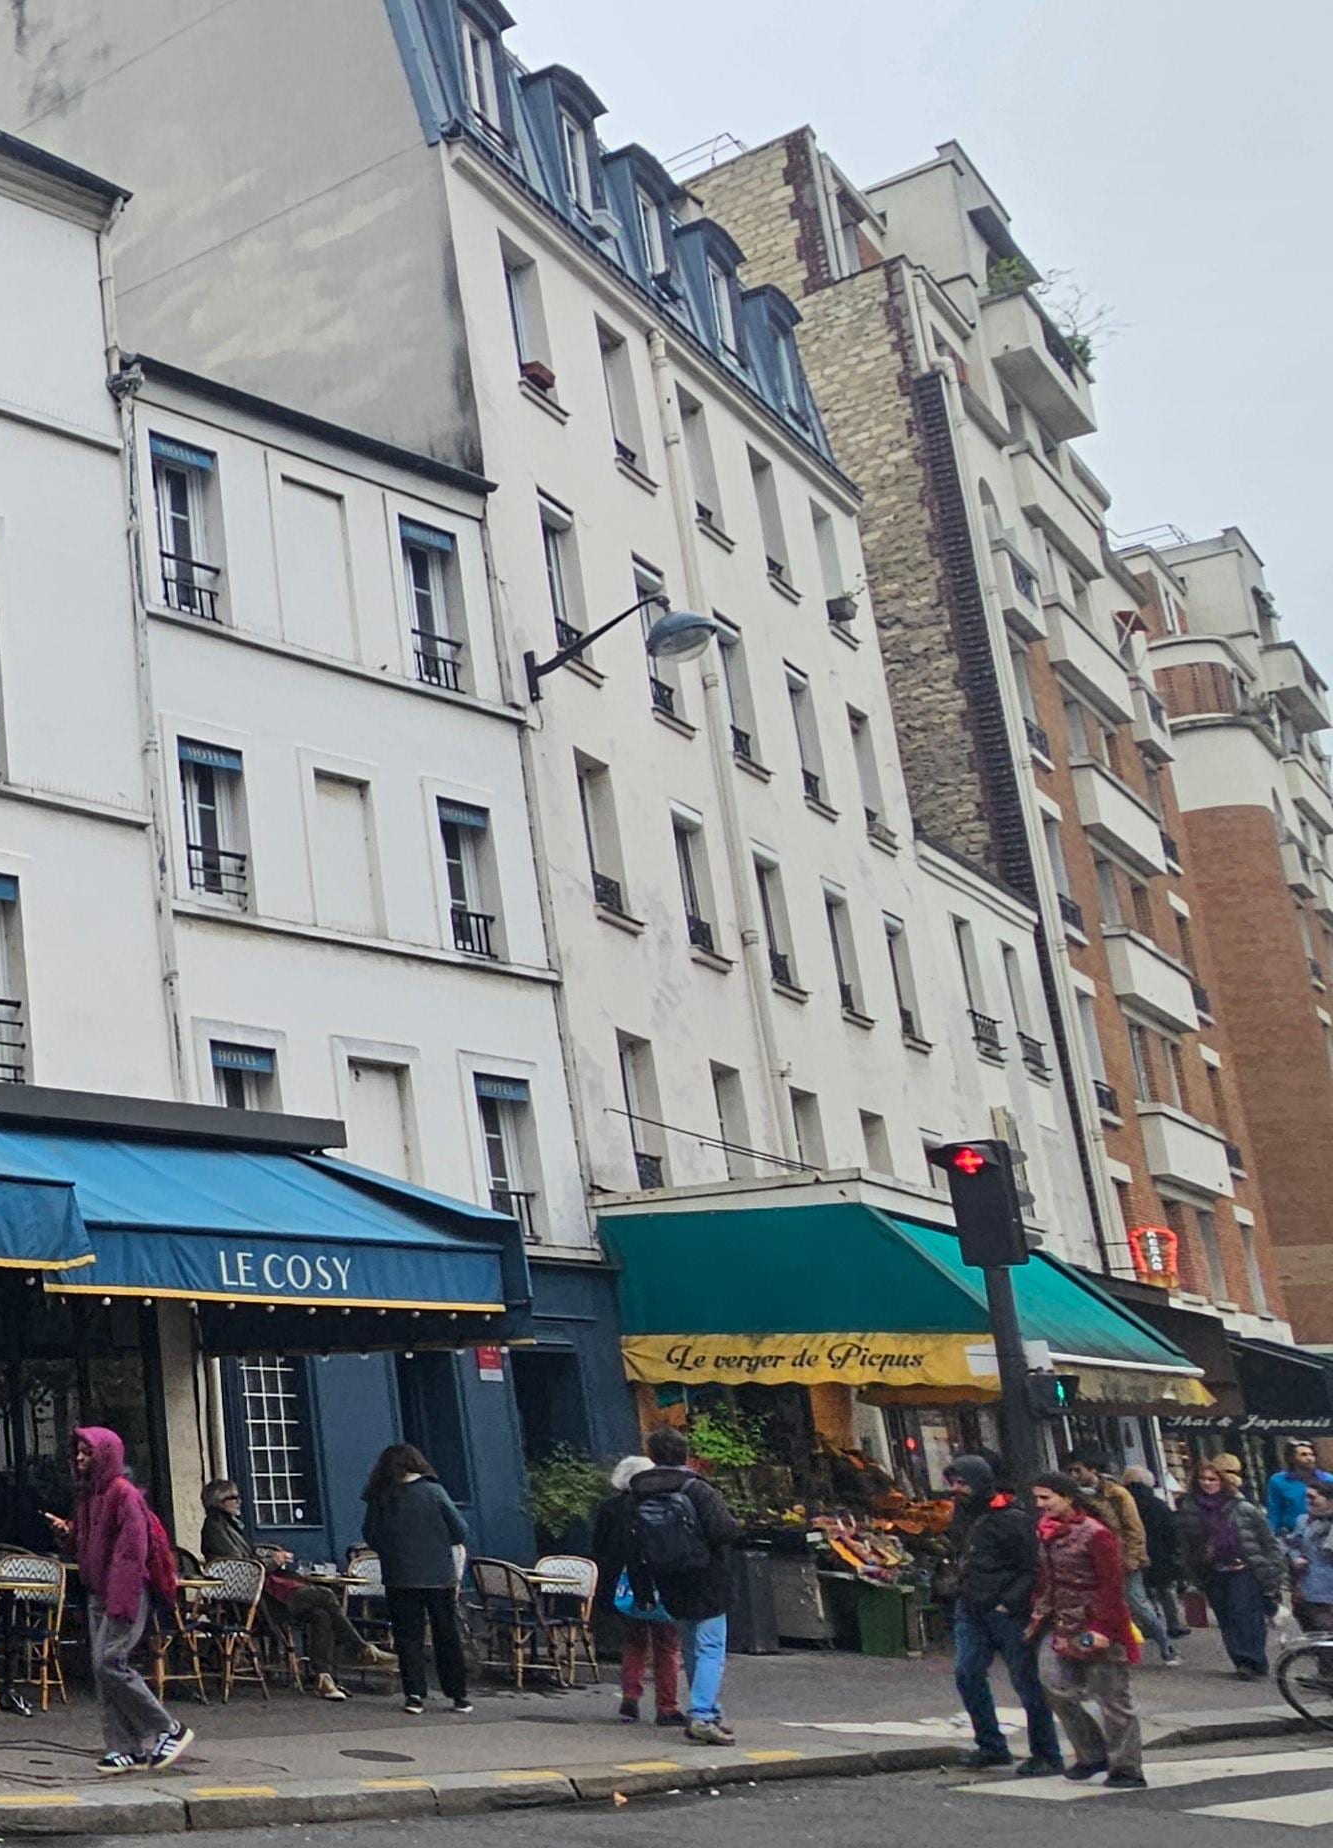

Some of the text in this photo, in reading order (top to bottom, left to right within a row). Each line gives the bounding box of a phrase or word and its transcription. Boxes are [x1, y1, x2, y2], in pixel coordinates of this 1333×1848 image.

[1146, 1228, 1163, 1271] KEBAB
[219, 1250, 351, 1290] LE COSY
[665, 1342, 925, 1373] Le verger de Picpus
[1239, 1414, 1332, 1431] Japonais
